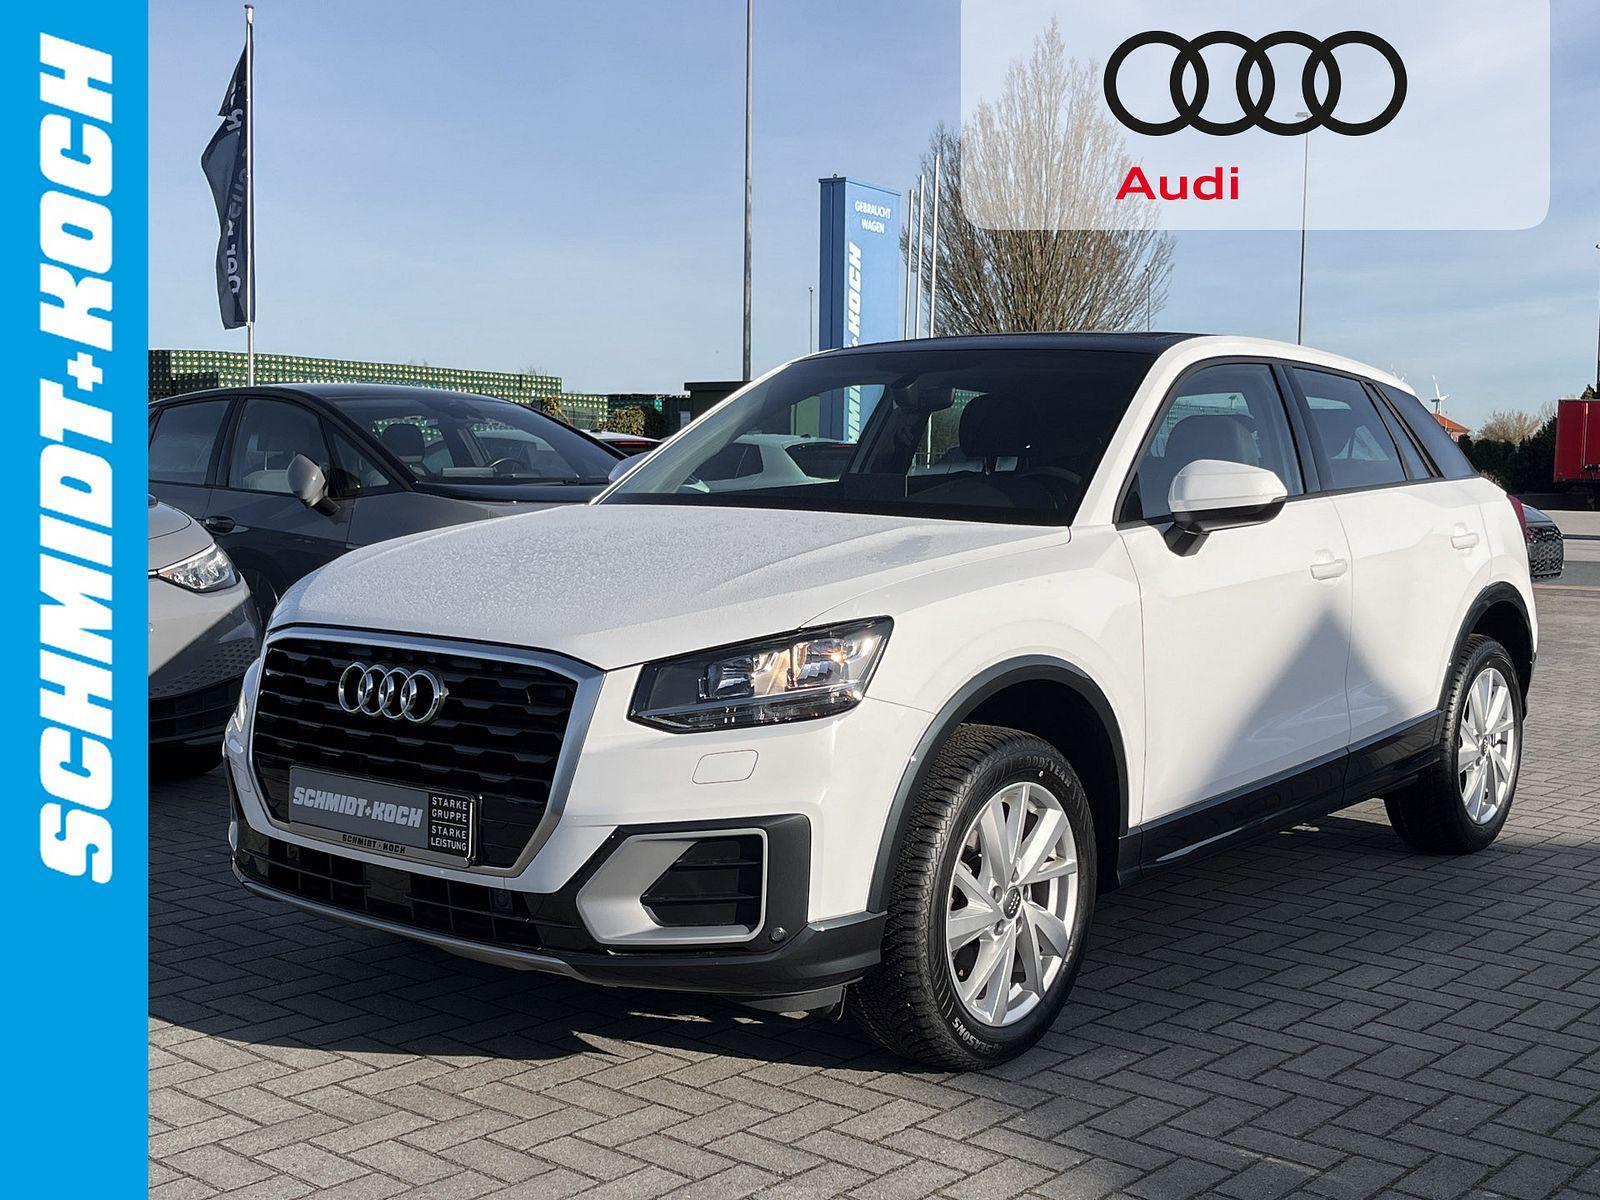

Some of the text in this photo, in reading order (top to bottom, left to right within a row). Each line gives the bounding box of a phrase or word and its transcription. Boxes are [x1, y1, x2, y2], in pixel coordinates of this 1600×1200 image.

[855, 200, 891, 219] GEBRAUCHT
[861, 218, 885, 233] WAGEN
[292, 786, 424, 828] SCHMIDT+KOCH
[431, 796, 468, 810] STARKE
[431, 809, 468, 822] GRUPPE
[431, 825, 467, 839] STARKE
[430, 836, 467, 851] LEISTUNG
